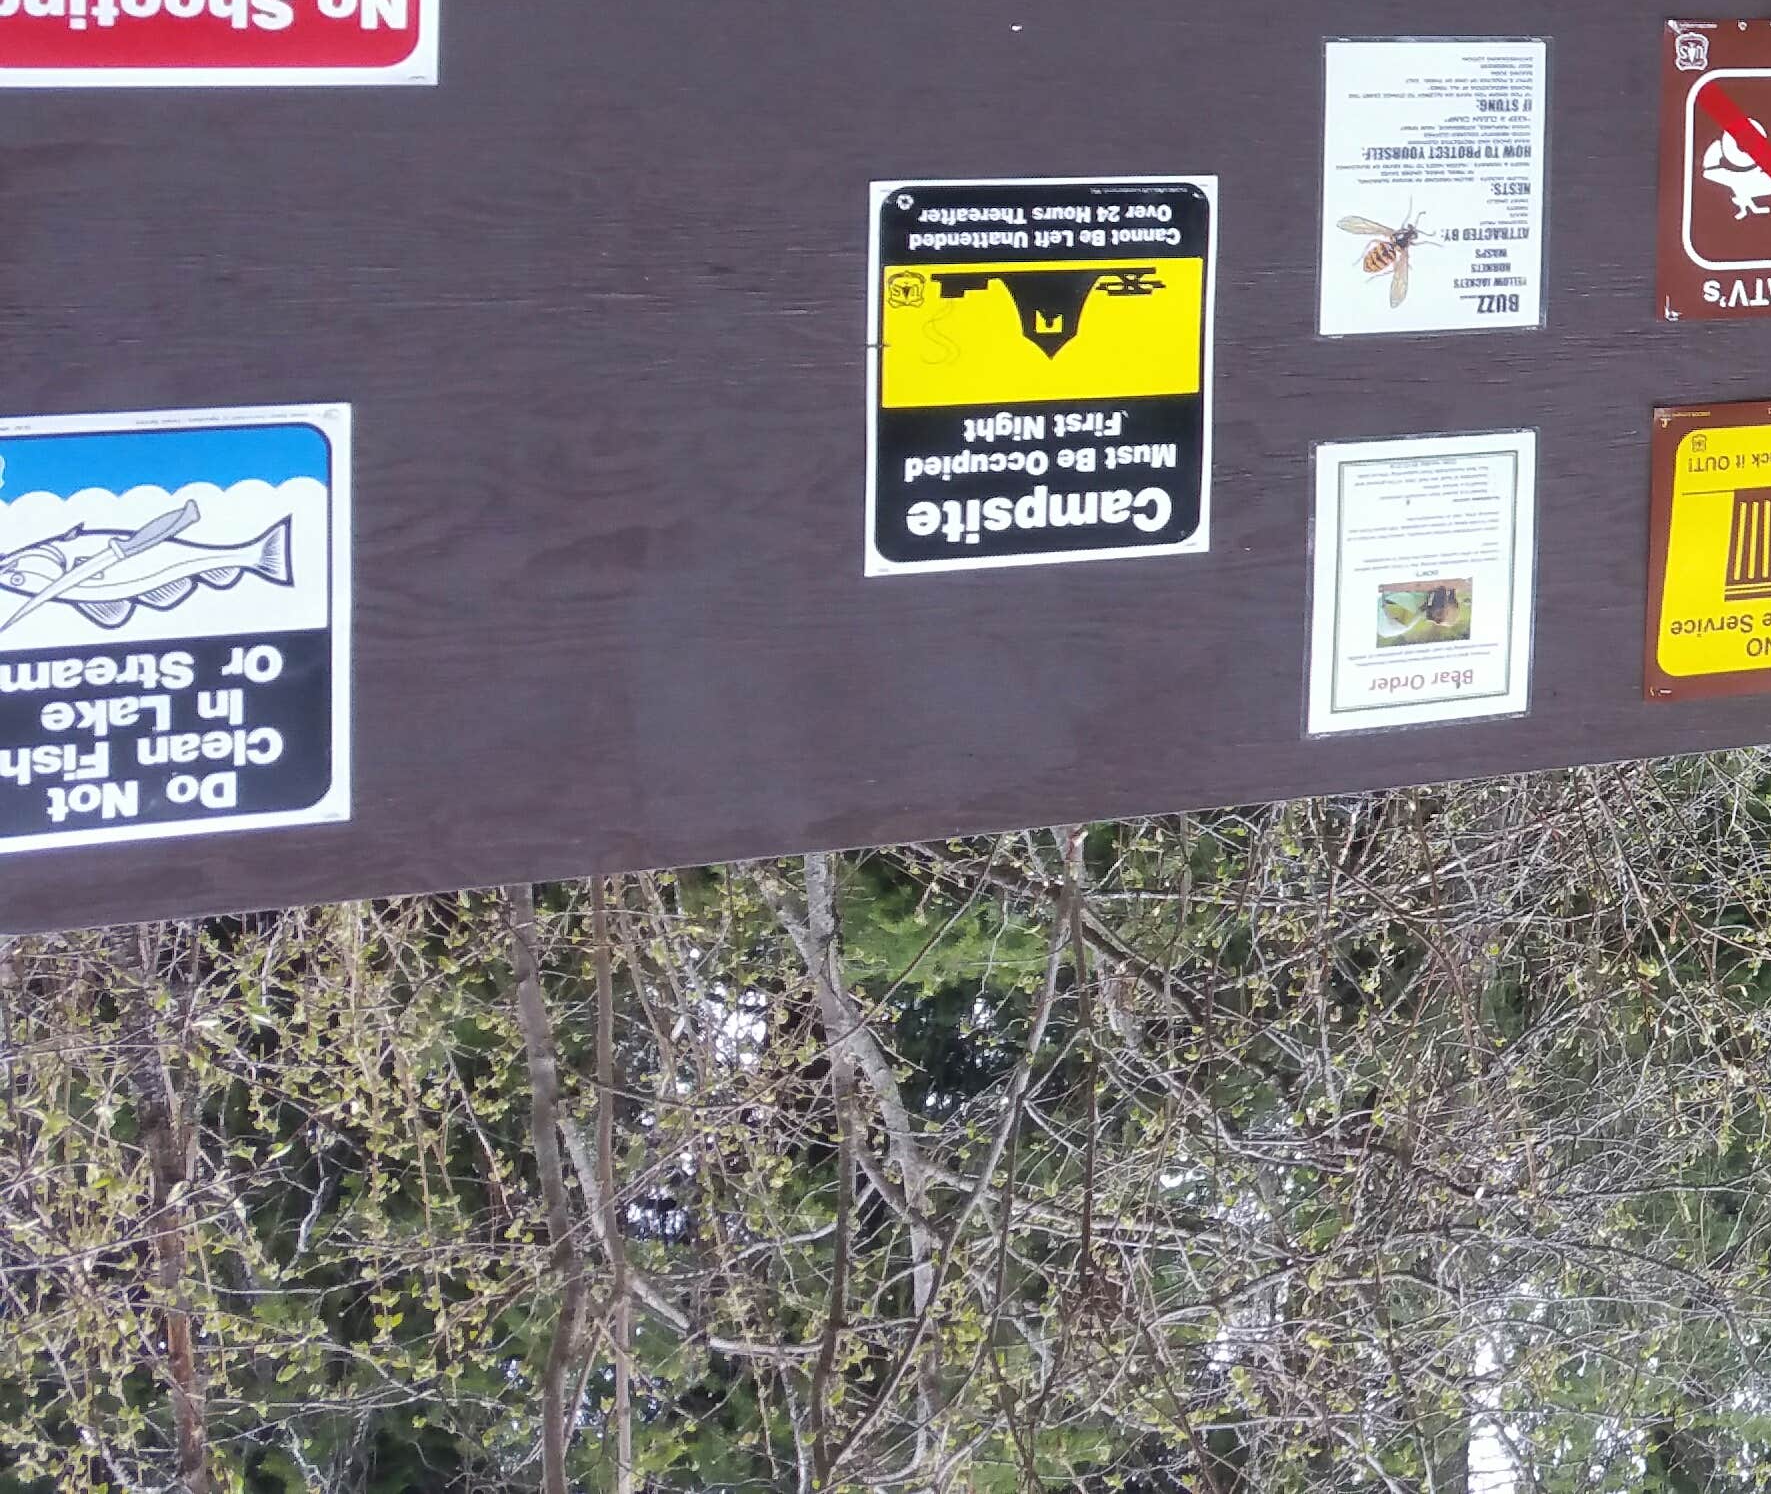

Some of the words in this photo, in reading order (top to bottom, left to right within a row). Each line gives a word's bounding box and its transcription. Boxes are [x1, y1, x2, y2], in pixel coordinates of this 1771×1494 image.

[1476, 99, 1519, 112] STUNG:
[1522, 99, 1532, 111] IF
[1361, 147, 1424, 161] YOURSELF:
[1428, 146, 1481, 159] PROTECT
[1485, 146, 1499, 158] TO
[1503, 146, 1532, 158] HOW
[1490, 182, 1531, 195] NESTS:
[918, 207, 1027, 225] Thereafter
[1032, 205, 1091, 224] Hours
[1096, 205, 1120, 222] 24
[1126, 203, 1172, 221] Over
[909, 230, 1028, 250] Unattended
[1035, 229, 1074, 249] Left
[1079, 229, 1106, 247] Be
[1112, 227, 1181, 246] Cannot
[1440, 228, 1459, 242] BY:
[1463, 227, 1529, 241] ATTRACTED
[1475, 248, 1507, 259] WASPS
[964, 411, 1045, 442] Night
[1053, 411, 1122, 437] First
[1057, 448, 1096, 473] Be
[1104, 443, 1176, 469] Must
[1688, 455, 1730, 472] OUT!
[1735, 454, 1745, 469] it
[904, 450, 1049, 482] Occupied
[906, 485, 1172, 544] Campsite
[1670, 614, 1754, 637] Service
[0, 651, 195, 694] Stream
[221, 644, 283, 683] Or
[1368, 673, 1424, 693] Order
[1431, 669, 1474, 687] Bear
[197, 688, 244, 723] In
[41, 695, 171, 737] Lake
[137, 727, 283, 767] Clean
[0, 741, 110, 785] Fish
[166, 771, 237, 809] Do
[47, 780, 138, 822] Not
